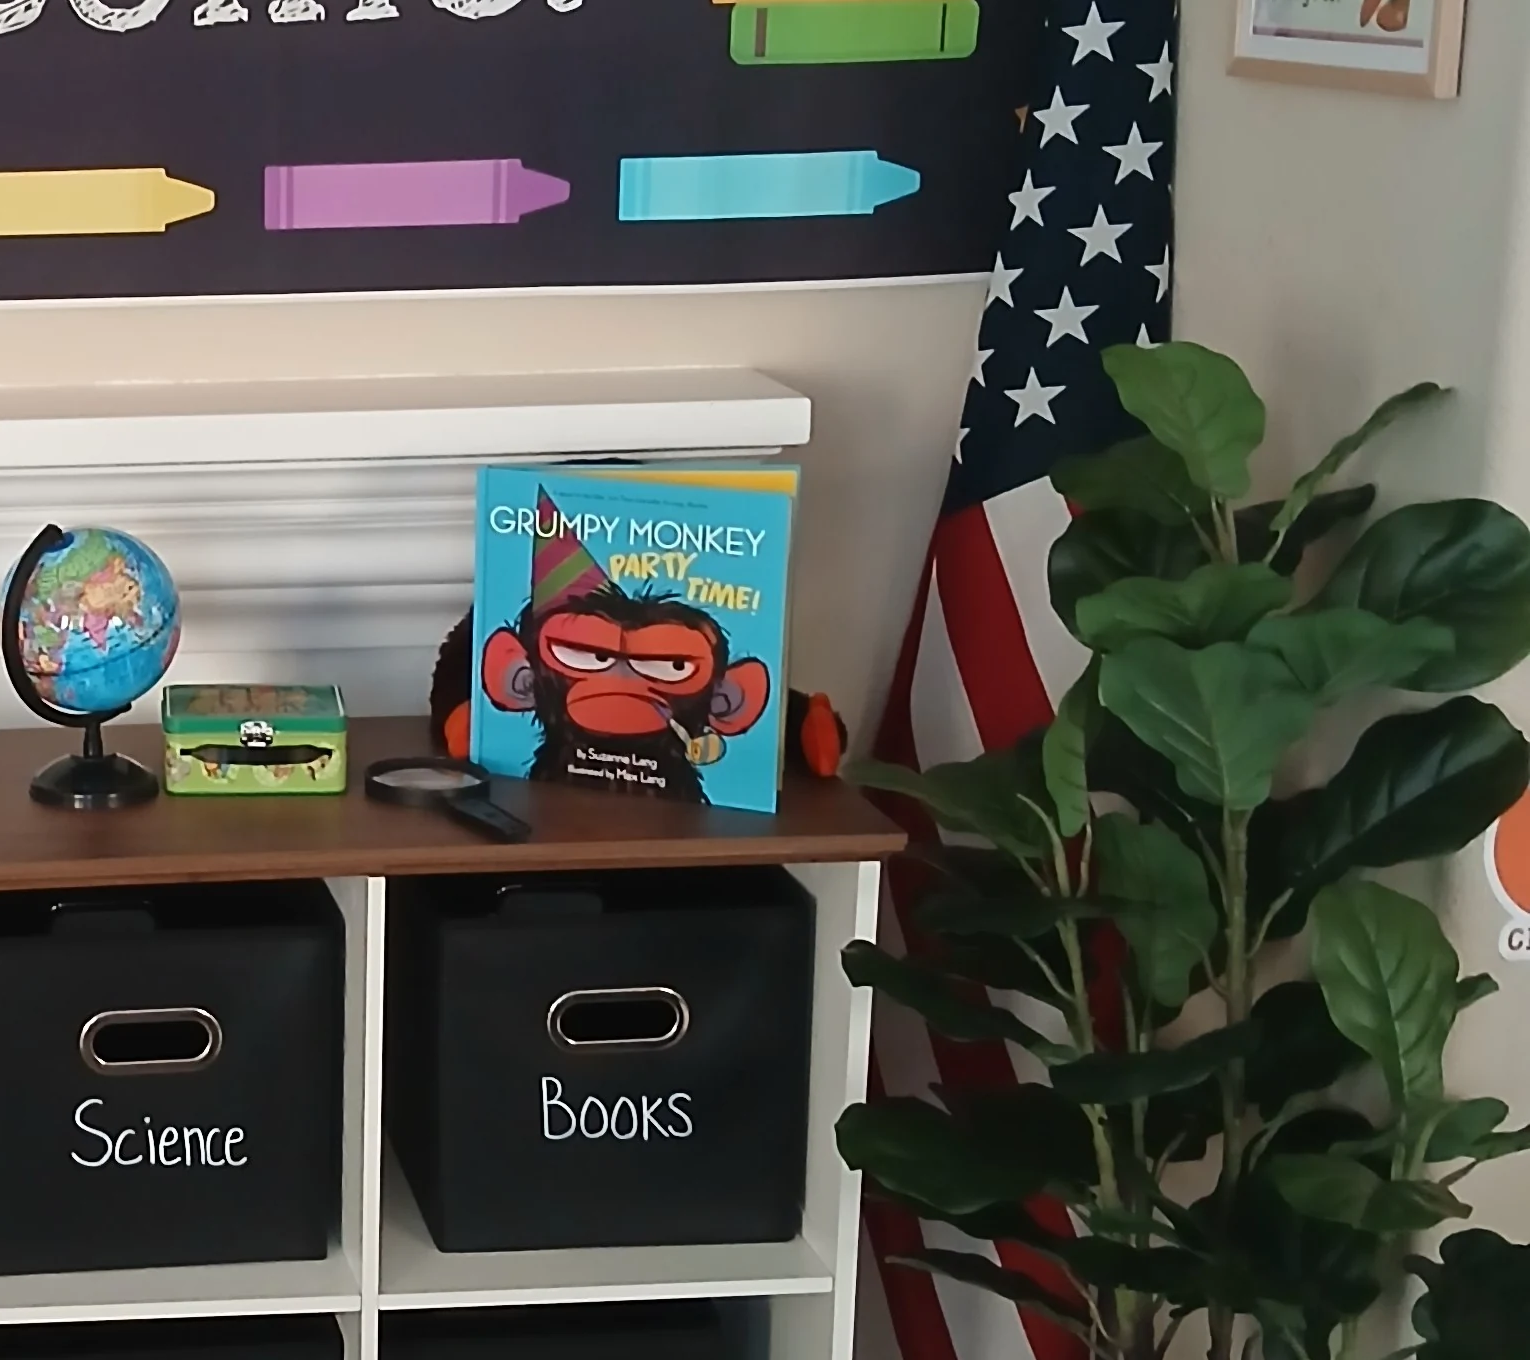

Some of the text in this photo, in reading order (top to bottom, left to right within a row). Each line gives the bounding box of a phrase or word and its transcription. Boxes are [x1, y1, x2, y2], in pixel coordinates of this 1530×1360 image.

[490, 505, 766, 557] GRUMPY MONKEY
[609, 551, 699, 582] PARTY
[70, 1097, 249, 1168] Science
